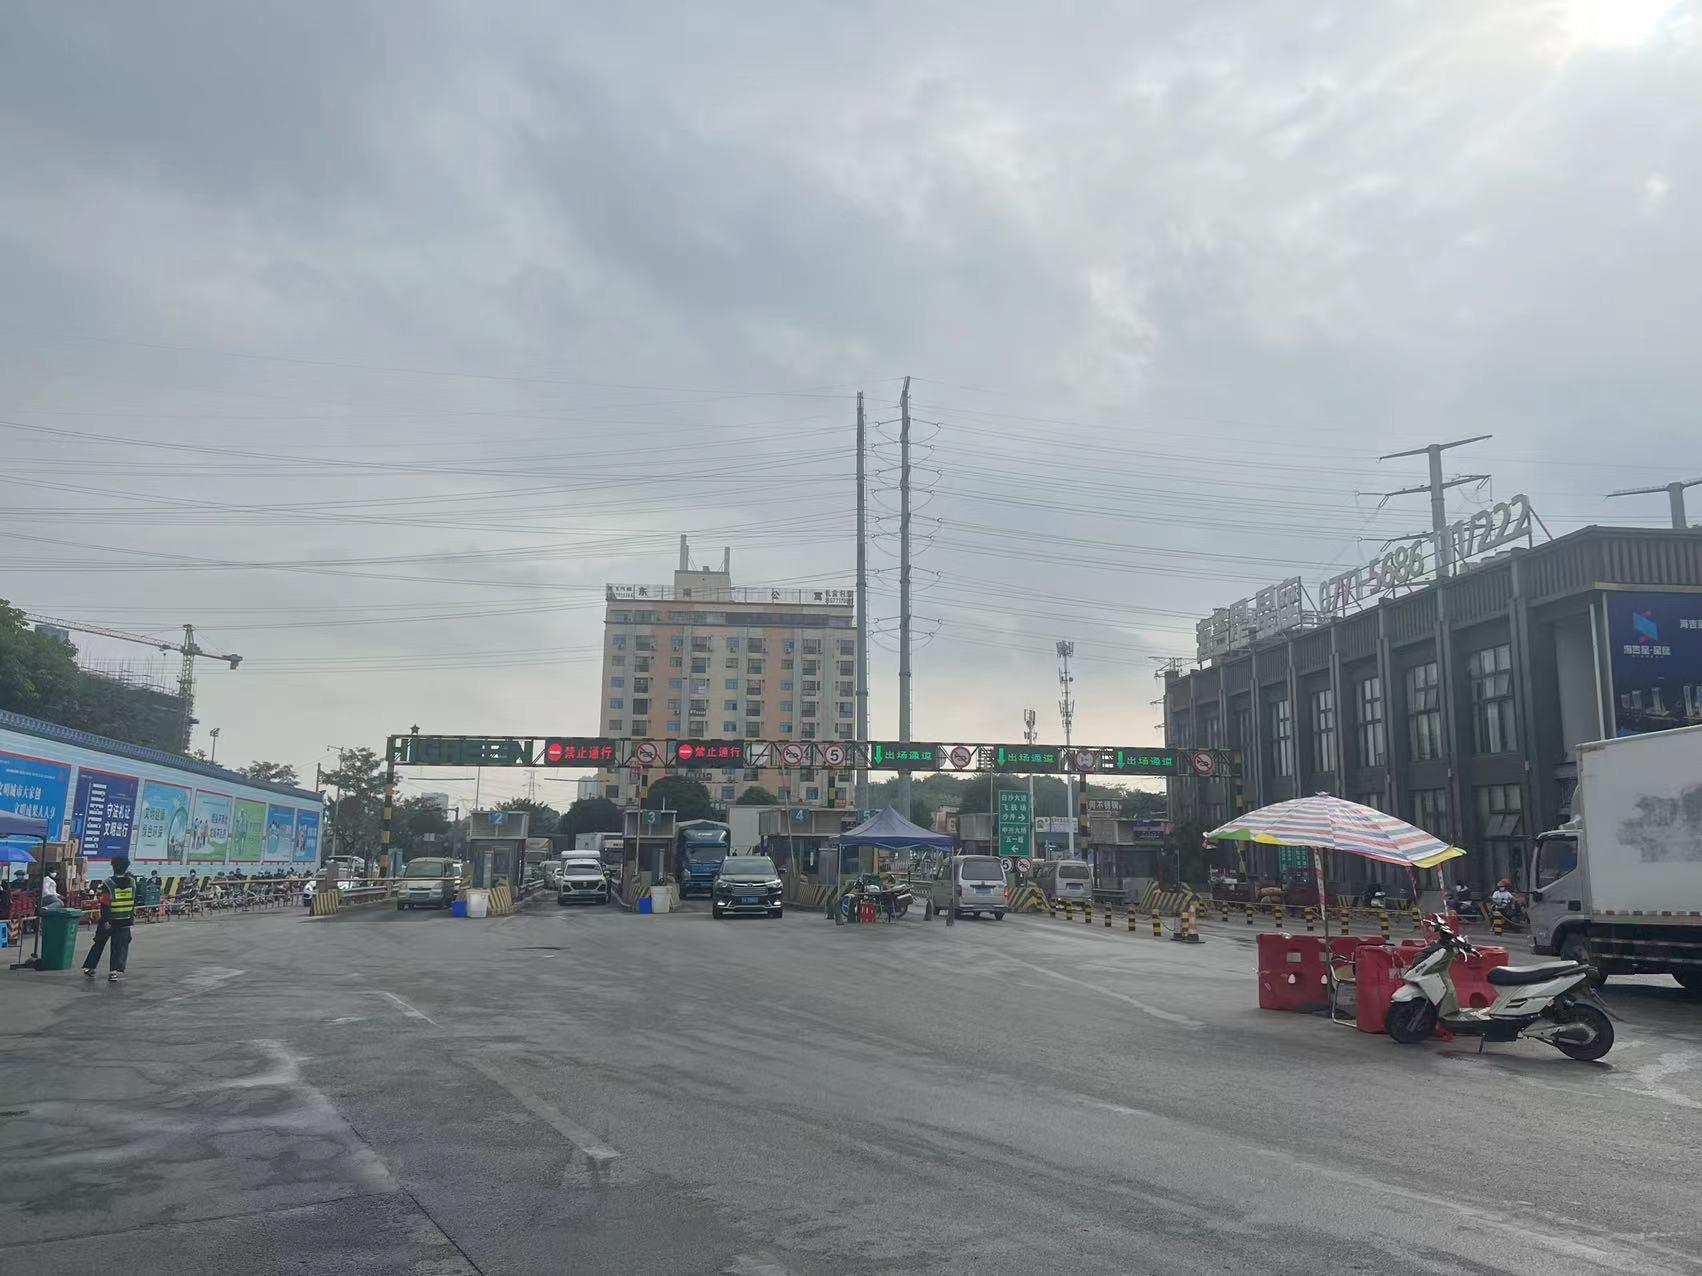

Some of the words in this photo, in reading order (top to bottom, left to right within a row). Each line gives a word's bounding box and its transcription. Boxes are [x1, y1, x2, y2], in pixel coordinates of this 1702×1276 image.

[564, 746, 613, 760] 禁止通行
[694, 746, 742, 759] 禁止通行
[829, 747, 839, 761] 5
[885, 751, 932, 761] 出场通道
[1007, 753, 1054, 764] 出场通道
[1126, 757, 1173, 767] 出场通道
[495, 813, 504, 825] 2
[648, 811, 656, 825] 3
[795, 809, 804, 819] 4
[863, 810, 871, 821] 5
[104, 821, 129, 838] 文明出行
[1002, 858, 1010, 870] 5
